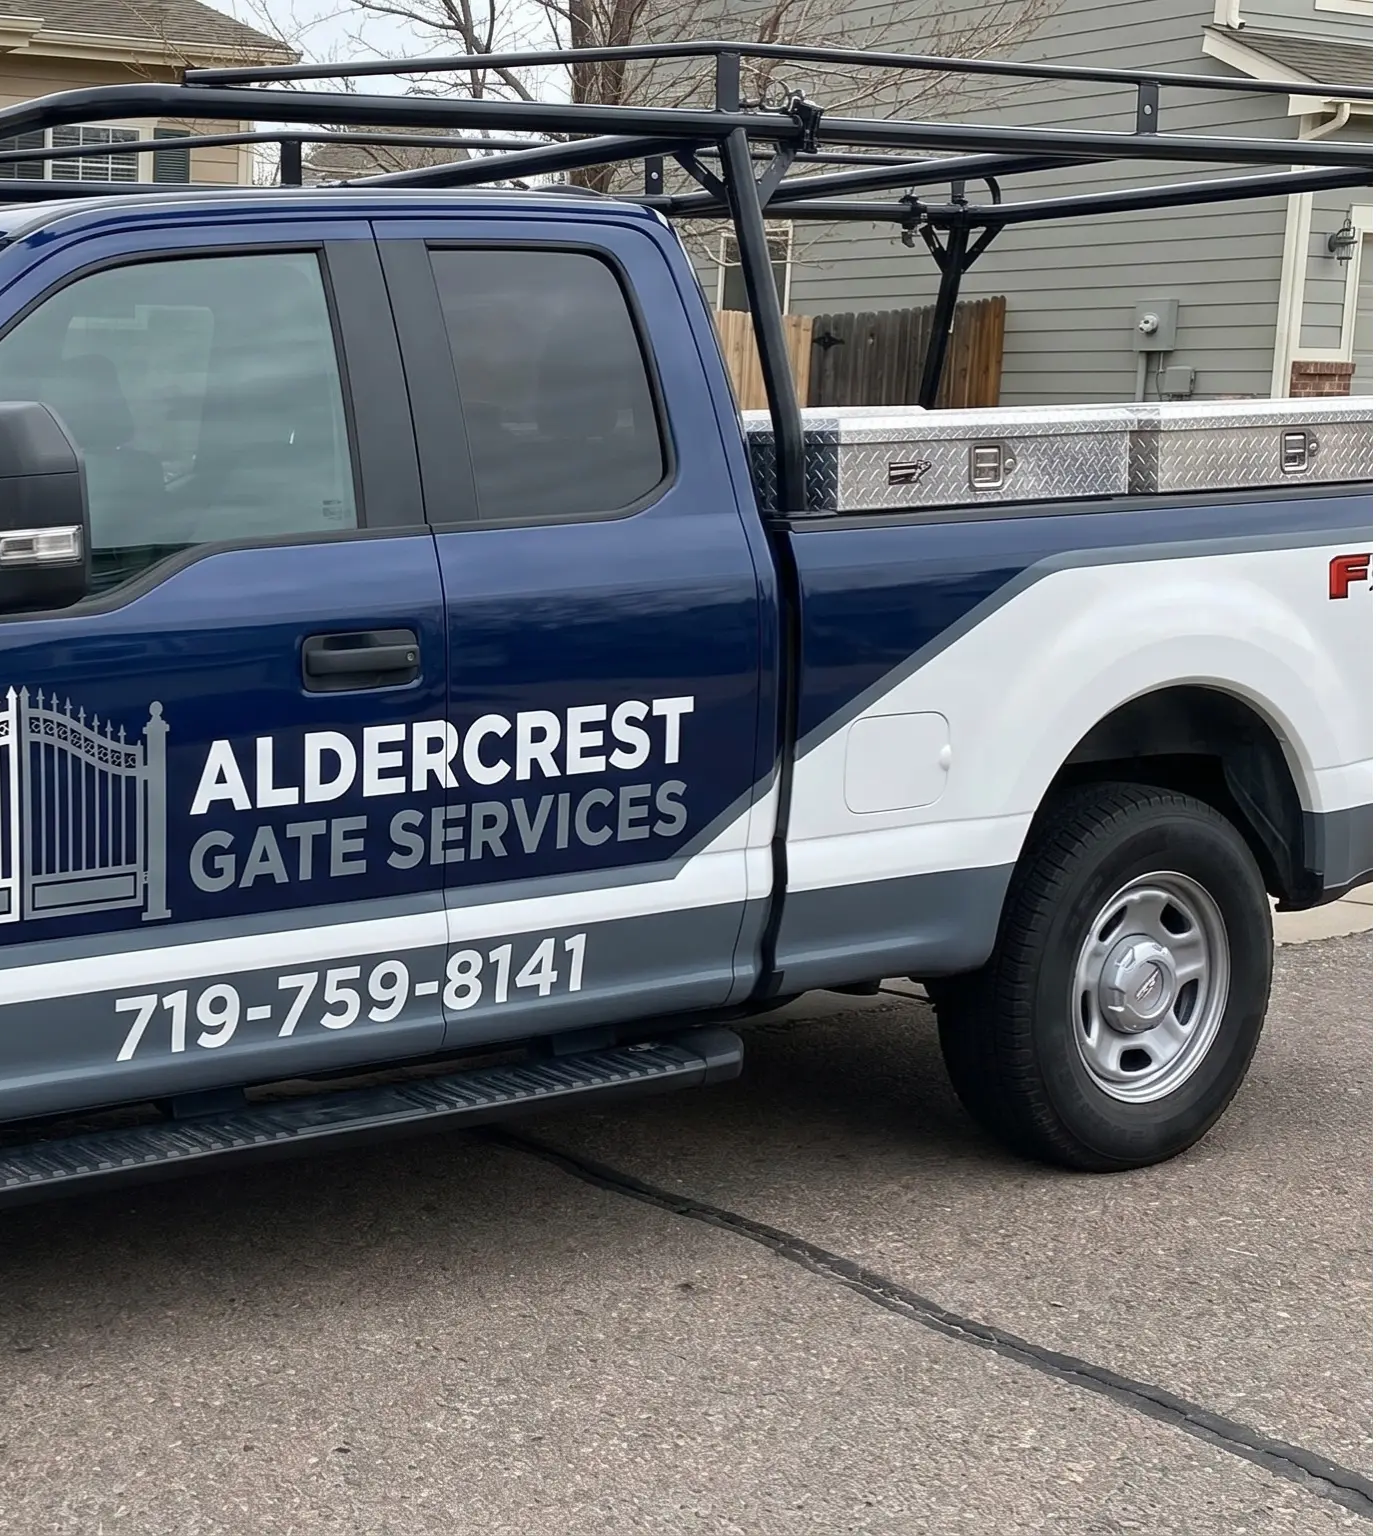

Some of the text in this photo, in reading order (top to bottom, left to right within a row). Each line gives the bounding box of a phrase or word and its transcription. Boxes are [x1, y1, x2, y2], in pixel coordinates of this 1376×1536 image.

[1329, 553, 1373, 600] F
[189, 695, 695, 816] ALDERCREST
[189, 778, 689, 893] GATE SERVICES
[114, 932, 587, 1063] 719-759-8141
